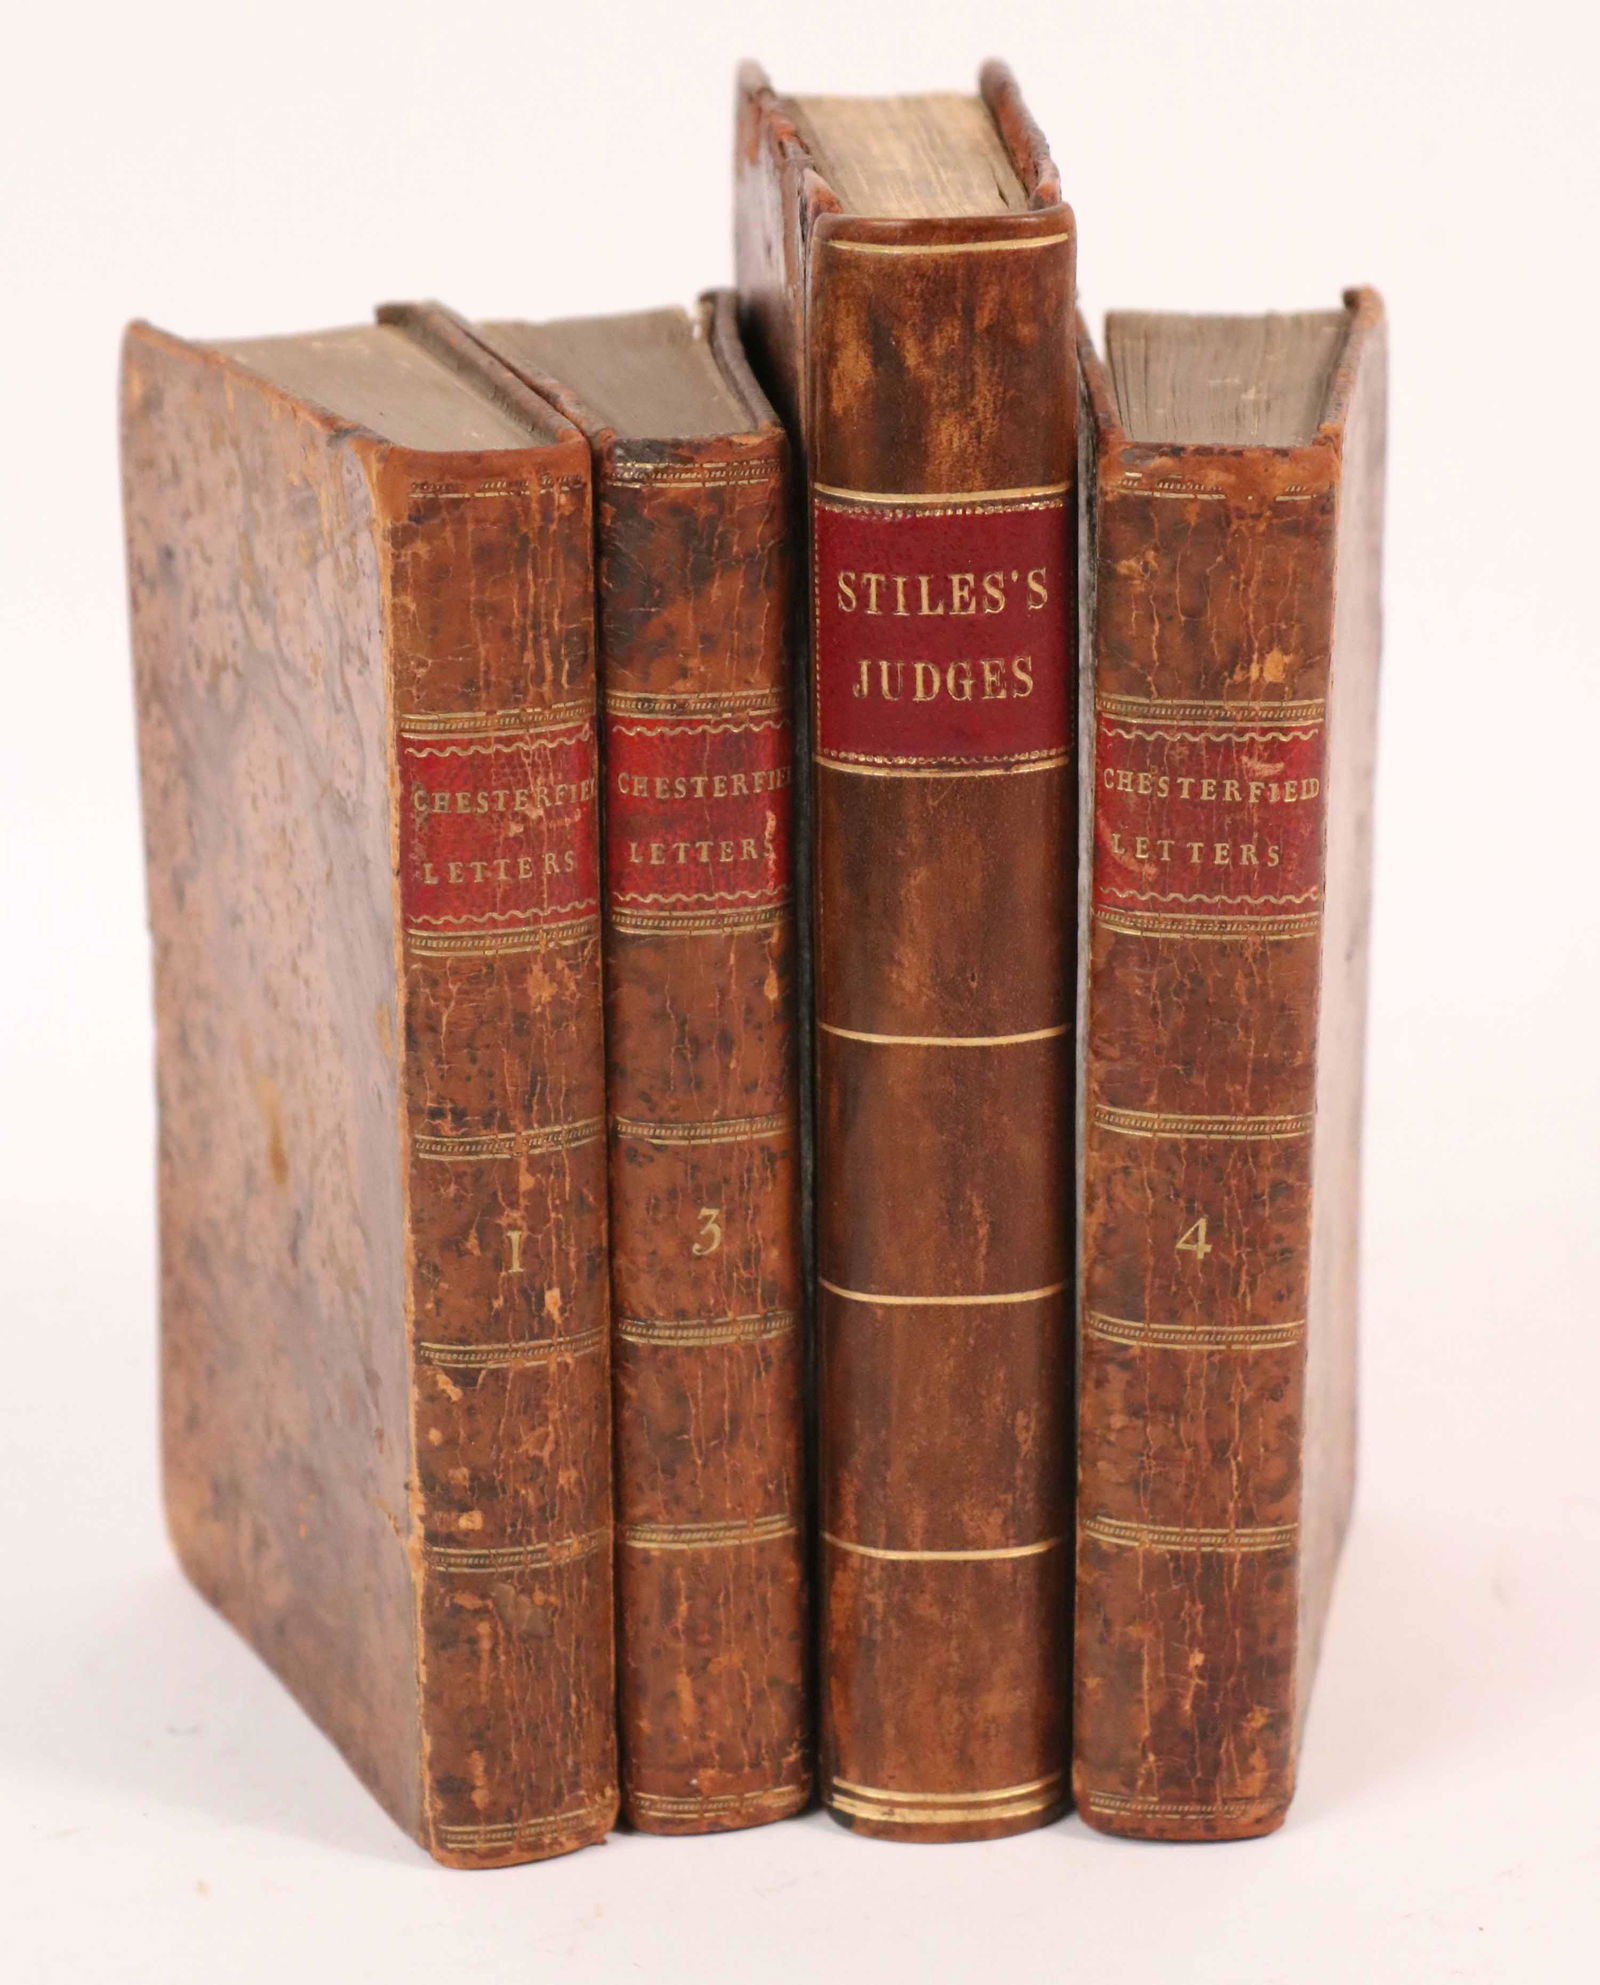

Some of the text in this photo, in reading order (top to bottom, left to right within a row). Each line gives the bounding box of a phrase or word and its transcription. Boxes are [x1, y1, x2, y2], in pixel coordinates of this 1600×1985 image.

[837, 567, 1049, 616] STILES'S
[852, 655, 1034, 702] JUDGES
[422, 851, 575, 884] LETTERS
[630, 838, 774, 865] LETTERS
[1111, 833, 1280, 867] LETTERS
[692, 1206, 721, 1256] 3
[1175, 1215, 1212, 1260] 4
